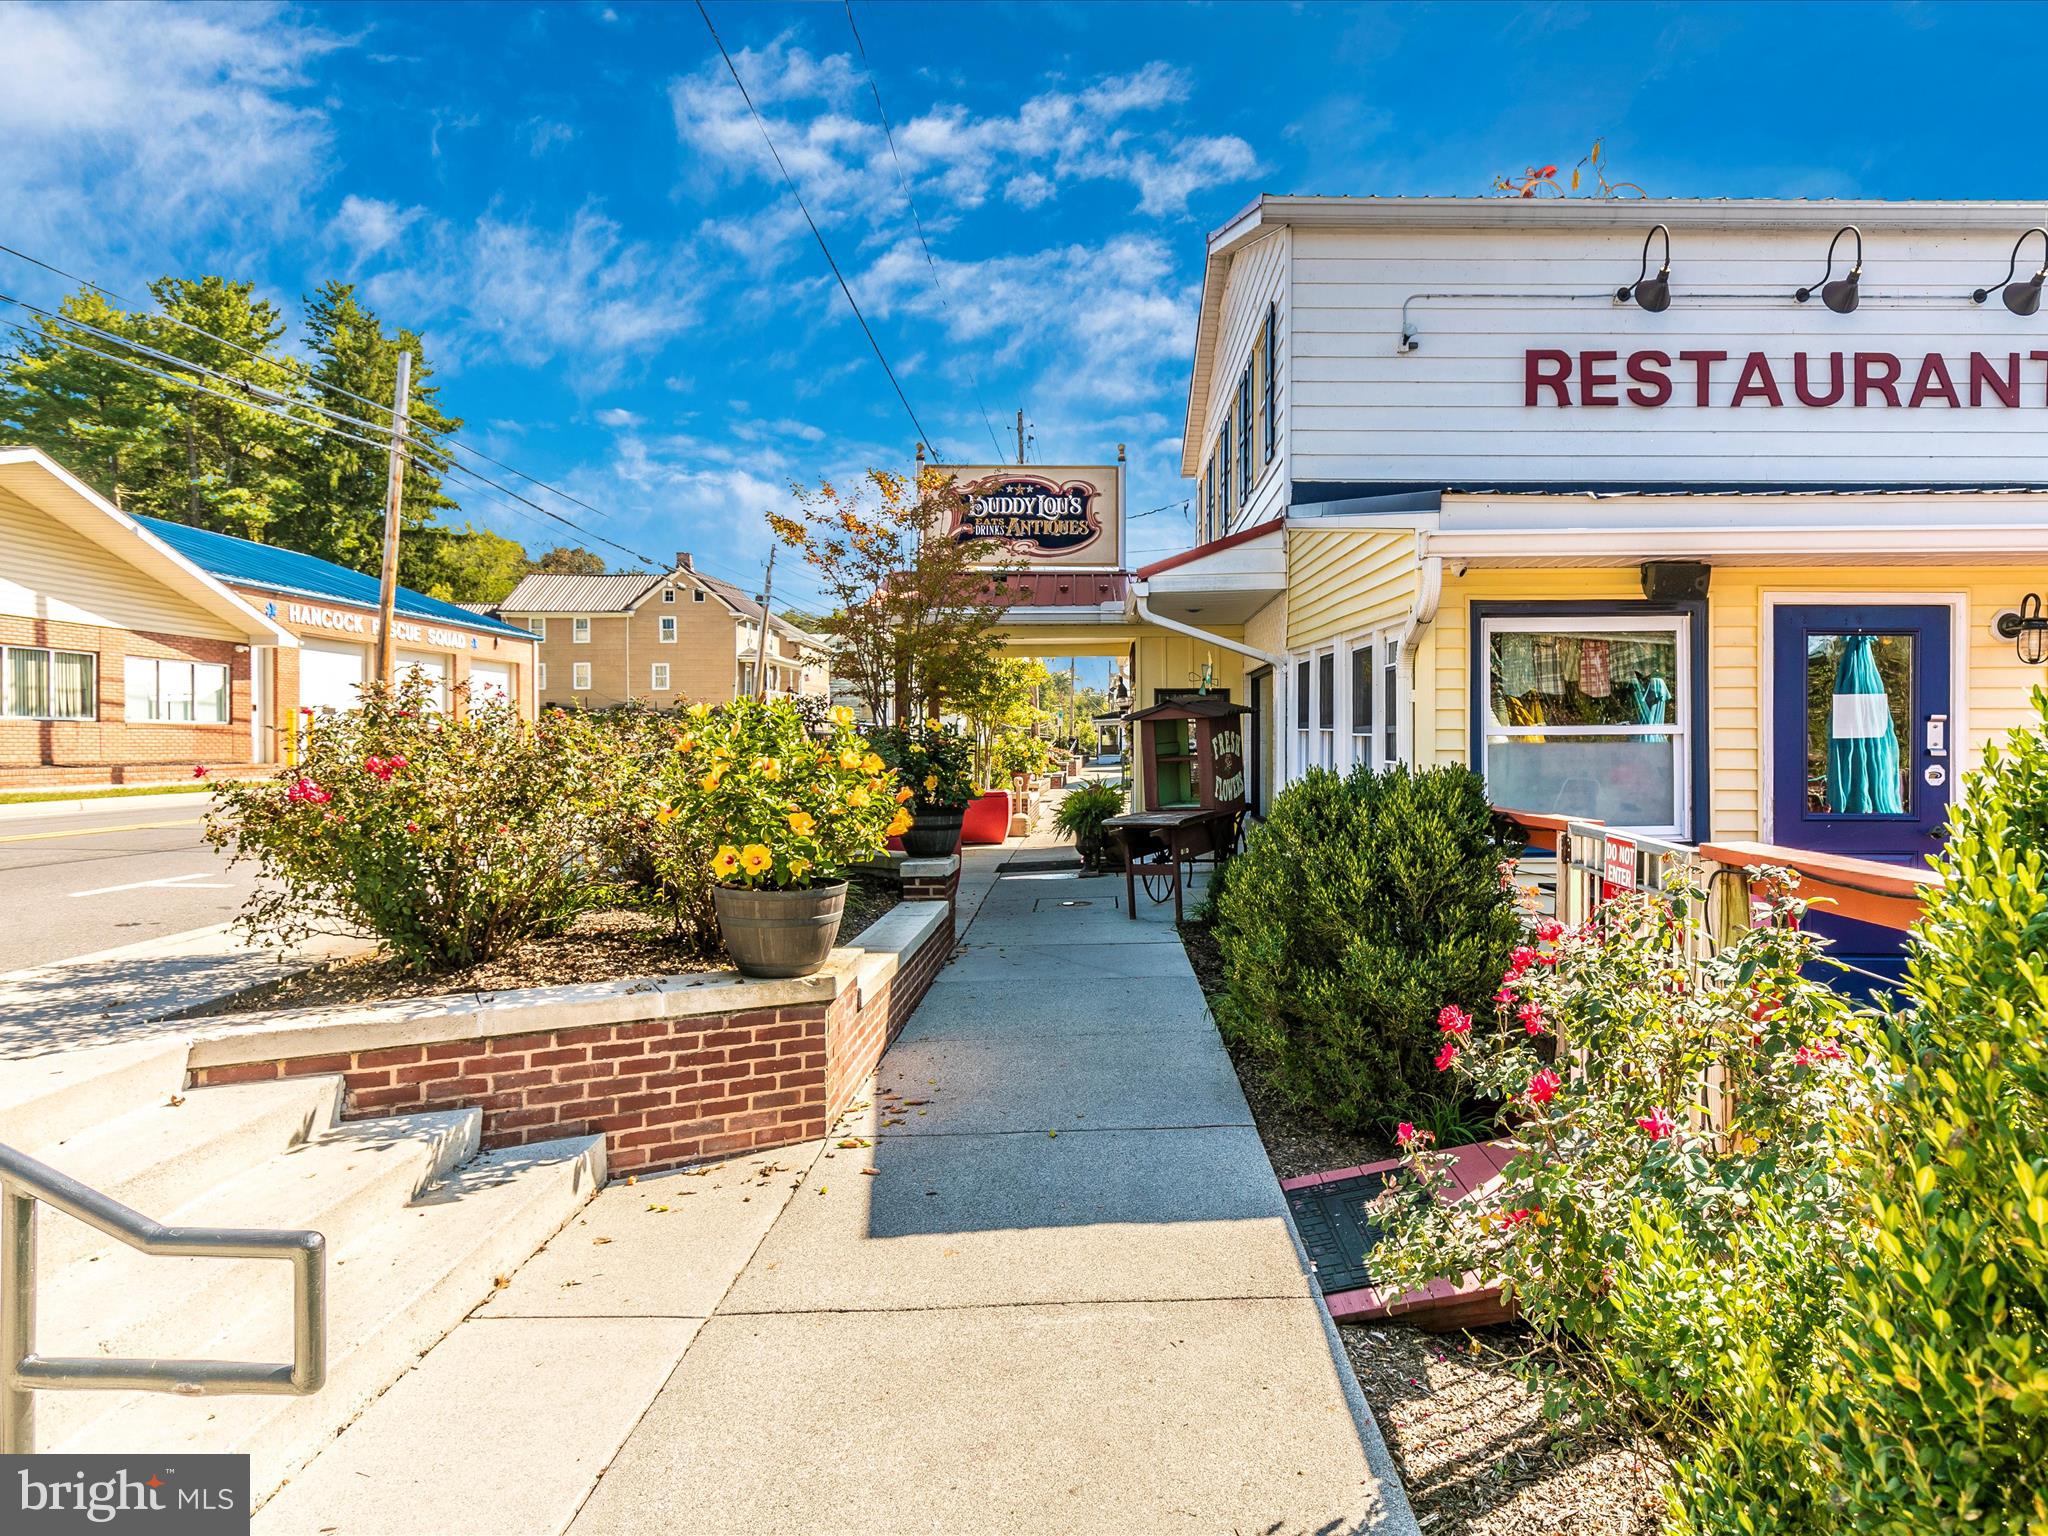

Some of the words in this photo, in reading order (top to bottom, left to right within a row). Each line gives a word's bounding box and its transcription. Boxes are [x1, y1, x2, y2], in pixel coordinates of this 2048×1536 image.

[968, 495, 1037, 518] BUDDY
[1036, 494, 1082, 520] LOU'S
[975, 517, 1005, 526] EATS
[975, 525, 1005, 536] DRINKS
[1005, 517, 1090, 537] ANTIQUES
[289, 604, 363, 633] HANCOCK
[371, 619, 421, 642] RSCUE
[427, 630, 467, 649] SQUAD
[1211, 730, 1240, 760] FRESH
[1214, 770, 1244, 801] FLOWERS
[1607, 842, 1617, 861] DO
[1619, 845, 1634, 865] NOT
[1608, 864, 1632, 887] ENTER
